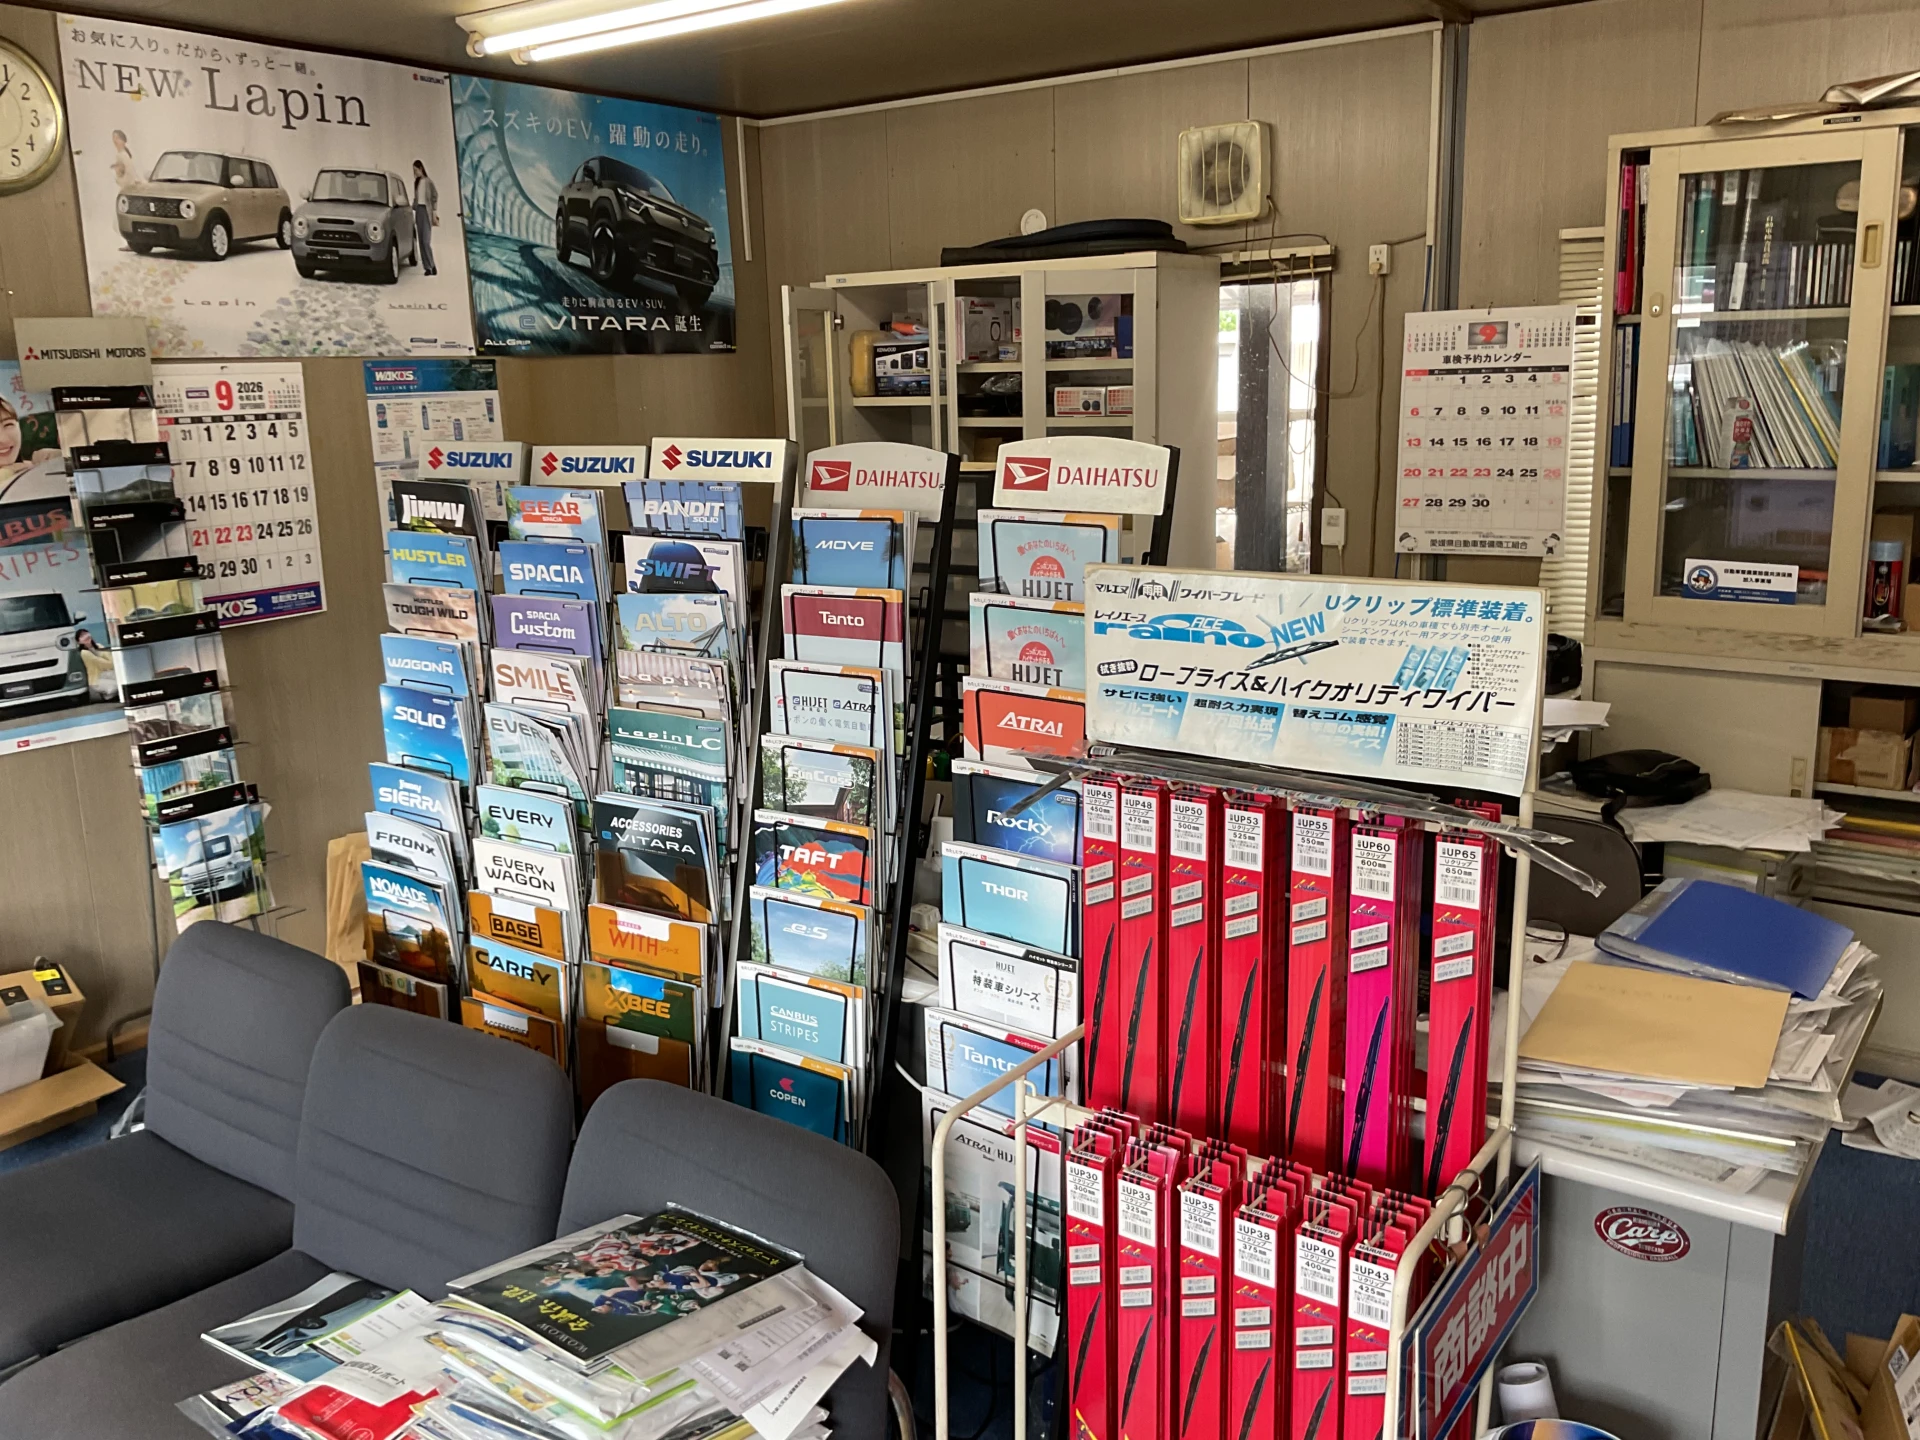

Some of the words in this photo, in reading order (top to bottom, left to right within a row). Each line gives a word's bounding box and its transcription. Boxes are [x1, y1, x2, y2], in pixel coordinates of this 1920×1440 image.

[21, 83, 31, 100] 2
[75, 59, 185, 99] NEW
[201, 66, 371, 130] Lapin
[30, 109, 41, 127] 3
[25, 134, 35, 151] 4
[11, 149, 21, 167] 5
[547, 315, 671, 332] VITARA
[674, 315, 702, 332] 誕生
[1479, 325, 1498, 342] 9
[40, 348, 100, 360] MITSUBISHI
[106, 347, 147, 359] MOTORS
[1442, 353, 1532, 365] 車検予約カレンダー
[215, 380, 234, 411] 9
[237, 381, 264, 394] 2026
[248, 456, 265, 473] 10
[268, 455, 285, 472] 11
[289, 454, 305, 470] 12
[447, 452, 512, 468] SUZUKI
[561, 457, 634, 473] SUZUKI
[686, 450, 772, 468] SUZUKI
[856, 468, 940, 489] DAIHATSU
[1056, 466, 1158, 488] DAIHATSU
[1403, 469, 1421, 477] 20
[1427, 469, 1444, 477] 21
[1450, 469, 1468, 477] 22
[1473, 469, 1491, 477] 23
[1496, 469, 1514, 477] 24
[1520, 469, 1538, 477] 25
[188, 496, 206, 512] 14
[210, 494, 227, 510] 15
[232, 492, 249, 508] 16
[252, 490, 268, 506] 17
[273, 488, 289, 504] 18
[293, 486, 309, 502] 19
[520, 501, 580, 514] GEAR
[644, 500, 724, 517] BANDIT
[402, 494, 465, 527] Jimny
[0, 508, 70, 540] BUS
[192, 530, 210, 547] 21
[214, 528, 232, 544] 22
[236, 525, 253, 541] 23
[257, 523, 274, 539] 24
[277, 521, 293, 537] 25
[297, 519, 312, 535] 26
[815, 540, 874, 551] MOVE
[393, 548, 467, 567] HUSTLER
[199, 563, 216, 579] 28
[220, 560, 237, 577] 29
[241, 558, 258, 574] 30
[509, 563, 584, 584] SPACIA
[634, 558, 720, 581] SWIFT
[1022, 579, 1074, 601] HIJET
[1095, 583, 1130, 595] マルエヌ
[1180, 588, 1267, 604] ワイパーブレード
[393, 604, 435, 616] TOUGH
[438, 608, 469, 620] WILD
[526, 610, 561, 621] SPACIA
[1094, 609, 1148, 623] レイノエース
[1324, 594, 1533, 623] Uクリップ標準装着。
[511, 612, 576, 640] Custom
[635, 612, 708, 632] ALTO
[818, 611, 865, 627] Tanto
[1191, 616, 1226, 631] ACE
[1271, 611, 1325, 646] NEW
[1343, 617, 1511, 633] Uクリップ以外の車種でも別売オール
[1339, 636, 1410, 648] で装着できます。
[1341, 627, 1512, 645] シーズンワイパー用アダプターの使用
[496, 663, 575, 696] SMILE
[1012, 663, 1063, 687] HIJET
[1099, 659, 1136, 676] 拭き抜群
[1139, 664, 1516, 713] ロープライス&ハイクオリティワイパー
[793, 706, 828, 714] CARGO
[802, 695, 828, 708] HIJET
[1103, 688, 1183, 703] サビに強い
[1193, 698, 1279, 717] 超耐久力実現
[1292, 707, 1389, 725] 替えゴム感覚
[394, 706, 446, 729] SOLIO
[997, 711, 1064, 737] ATRAI
[379, 788, 445, 814] SIERRA
[1090, 790, 1112, 799] UP45
[1129, 799, 1153, 809] UP48
[489, 805, 553, 828] EVERY
[1178, 805, 1203, 815] UP50
[610, 816, 683, 838] ACCESSORIES
[987, 809, 1053, 836] Rocky
[1234, 815, 1259, 825] UP53
[1302, 820, 1328, 830] UP55
[615, 832, 696, 855] VITARA
[1300, 830, 1324, 838] Uクリップ
[376, 831, 436, 857] FRONX
[1361, 840, 1390, 852] UP60
[1447, 848, 1476, 859] UP65
[779, 844, 843, 869] TAFT
[1360, 851, 1386, 859] Uクリップ
[1445, 859, 1473, 867] Uクリップ
[492, 855, 544, 877] EVERY
[484, 866, 555, 893] WAGON
[369, 876, 428, 904] NOMADE
[981, 881, 1029, 902] THOR
[493, 917, 539, 940] BASE
[608, 928, 658, 956] WITH
[475, 949, 552, 985] CARRY
[995, 961, 1016, 974] HIJET
[972, 974, 1042, 1003] 特装車シリーズ
[604, 984, 671, 1019] XBEE
[770, 1005, 819, 1026] CANBUS
[770, 1020, 819, 1043] STRIPES
[769, 1089, 806, 1107] COPEN
[954, 1133, 992, 1155] ATRAI
[1073, 1169, 1098, 1181] UP30
[1126, 1187, 1151, 1201] UP33
[1189, 1198, 1214, 1211] UP35
[1243, 1226, 1270, 1241] UP38
[1608, 1217, 1678, 1246] Carp
[1306, 1242, 1335, 1258] UP40
[1360, 1265, 1390, 1281] UP43
[1434, 1220, 1527, 1418] 商談中
[537, 1323, 589, 1353] WOWOW
